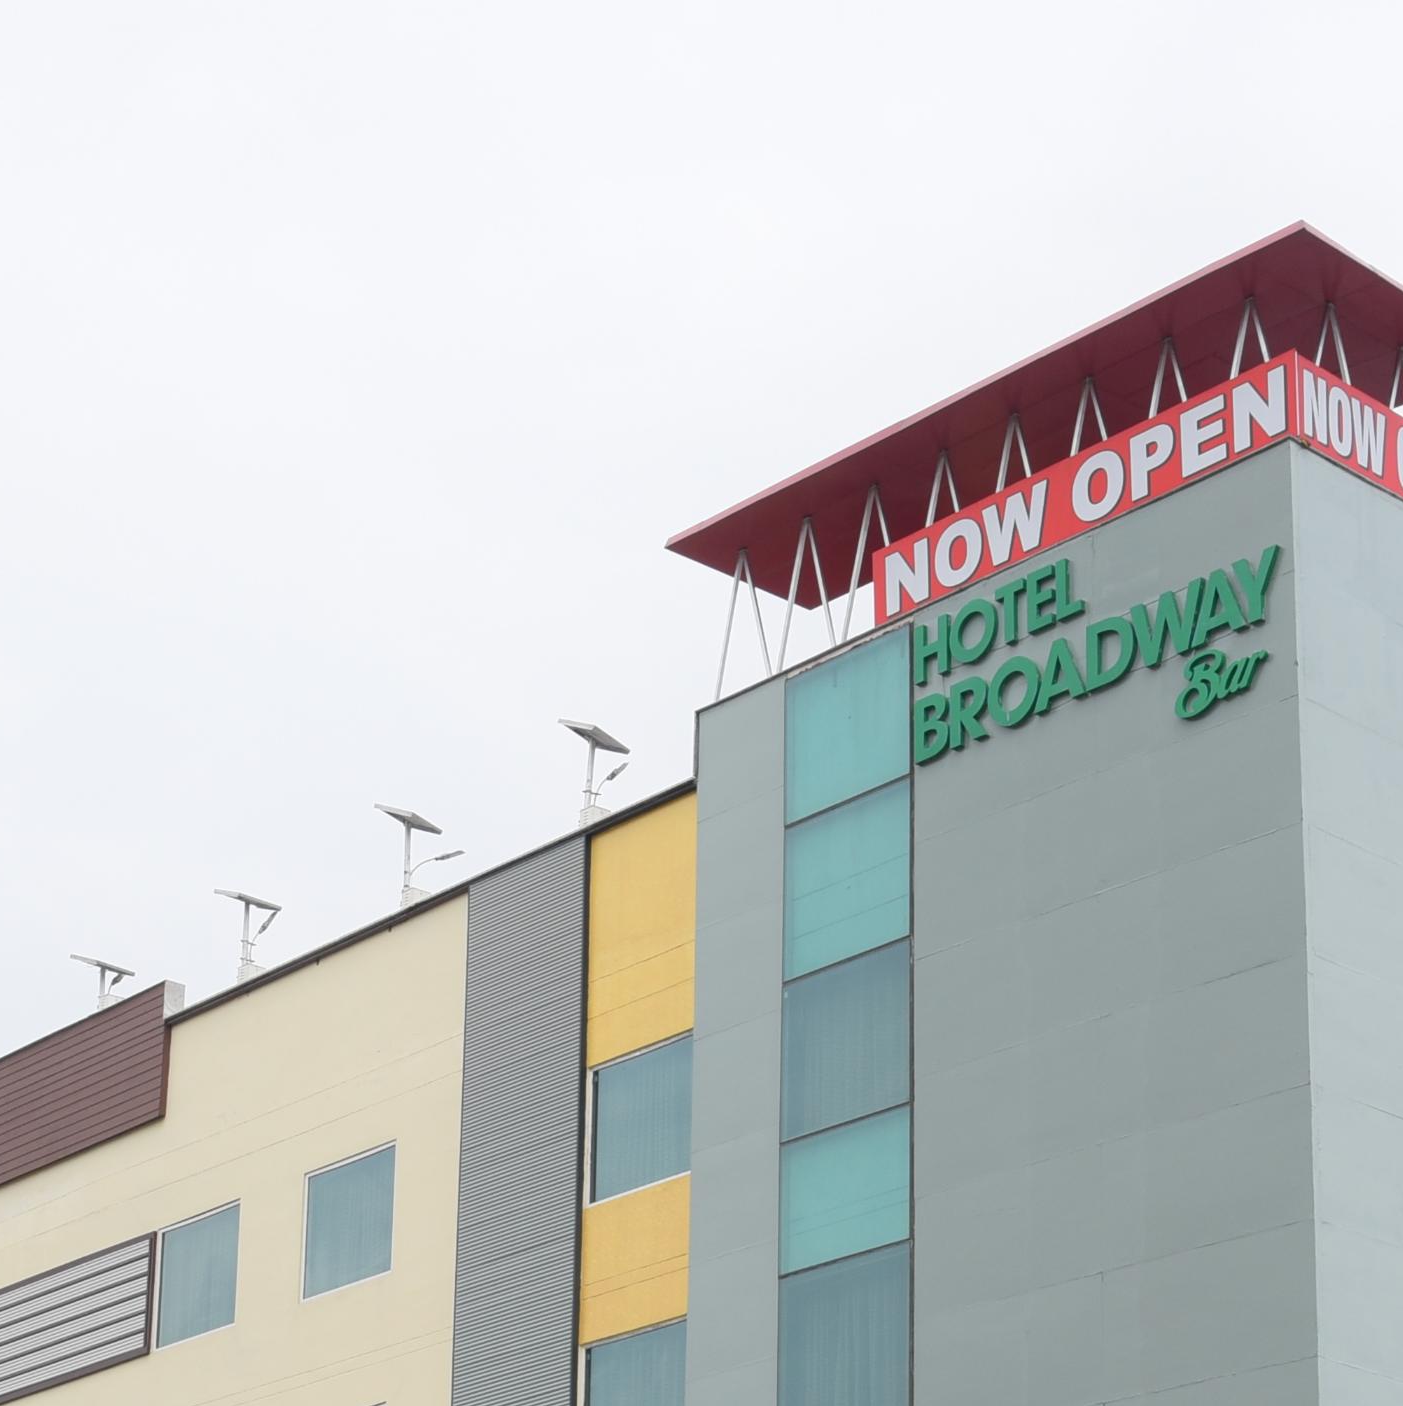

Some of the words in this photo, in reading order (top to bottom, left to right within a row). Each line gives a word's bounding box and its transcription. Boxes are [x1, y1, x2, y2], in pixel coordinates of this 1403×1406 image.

[1302, 367, 1387, 479] NOW
[883, 477, 1049, 619] NOW
[1071, 363, 1287, 523] OPEN
[914, 557, 1086, 687] HOTEL
[914, 543, 1282, 766] BROADWAY
[1174, 648, 1270, 720] Bar
